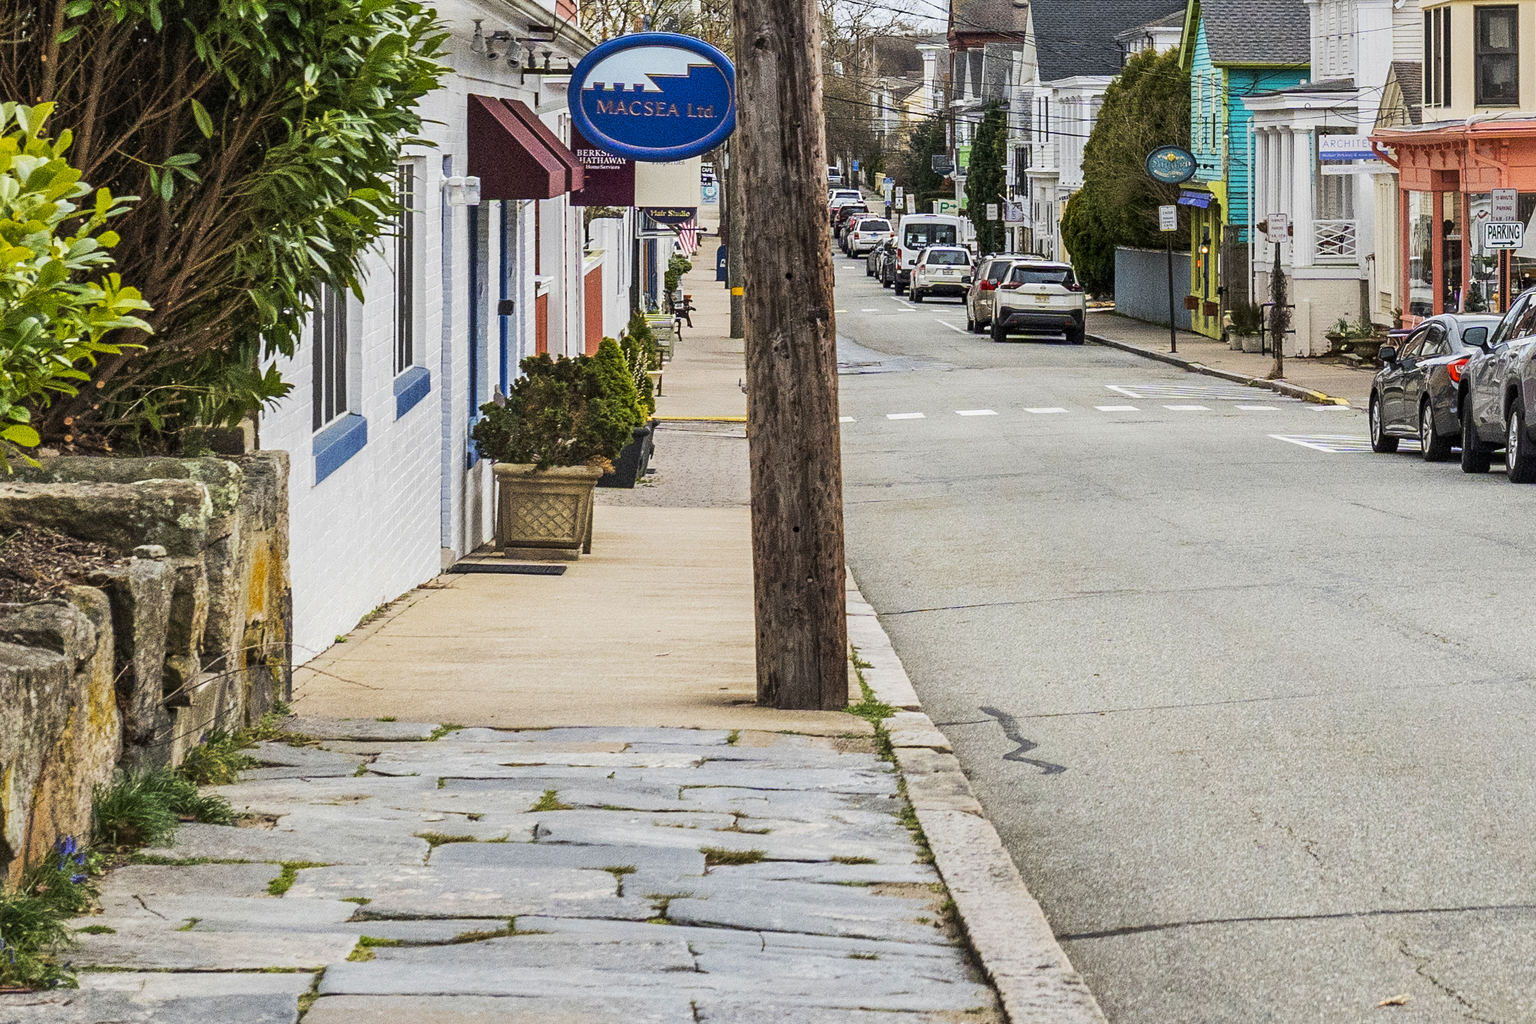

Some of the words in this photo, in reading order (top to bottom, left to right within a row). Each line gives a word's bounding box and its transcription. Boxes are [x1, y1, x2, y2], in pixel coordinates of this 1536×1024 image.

[597, 100, 680, 117] MACSEA
[687, 103, 718, 118] Ltd.
[579, 157, 627, 165] HATHAWAY
[650, 209, 666, 217] Hair
[668, 209, 691, 217] Studio
[1487, 224, 1520, 239] PARKING
